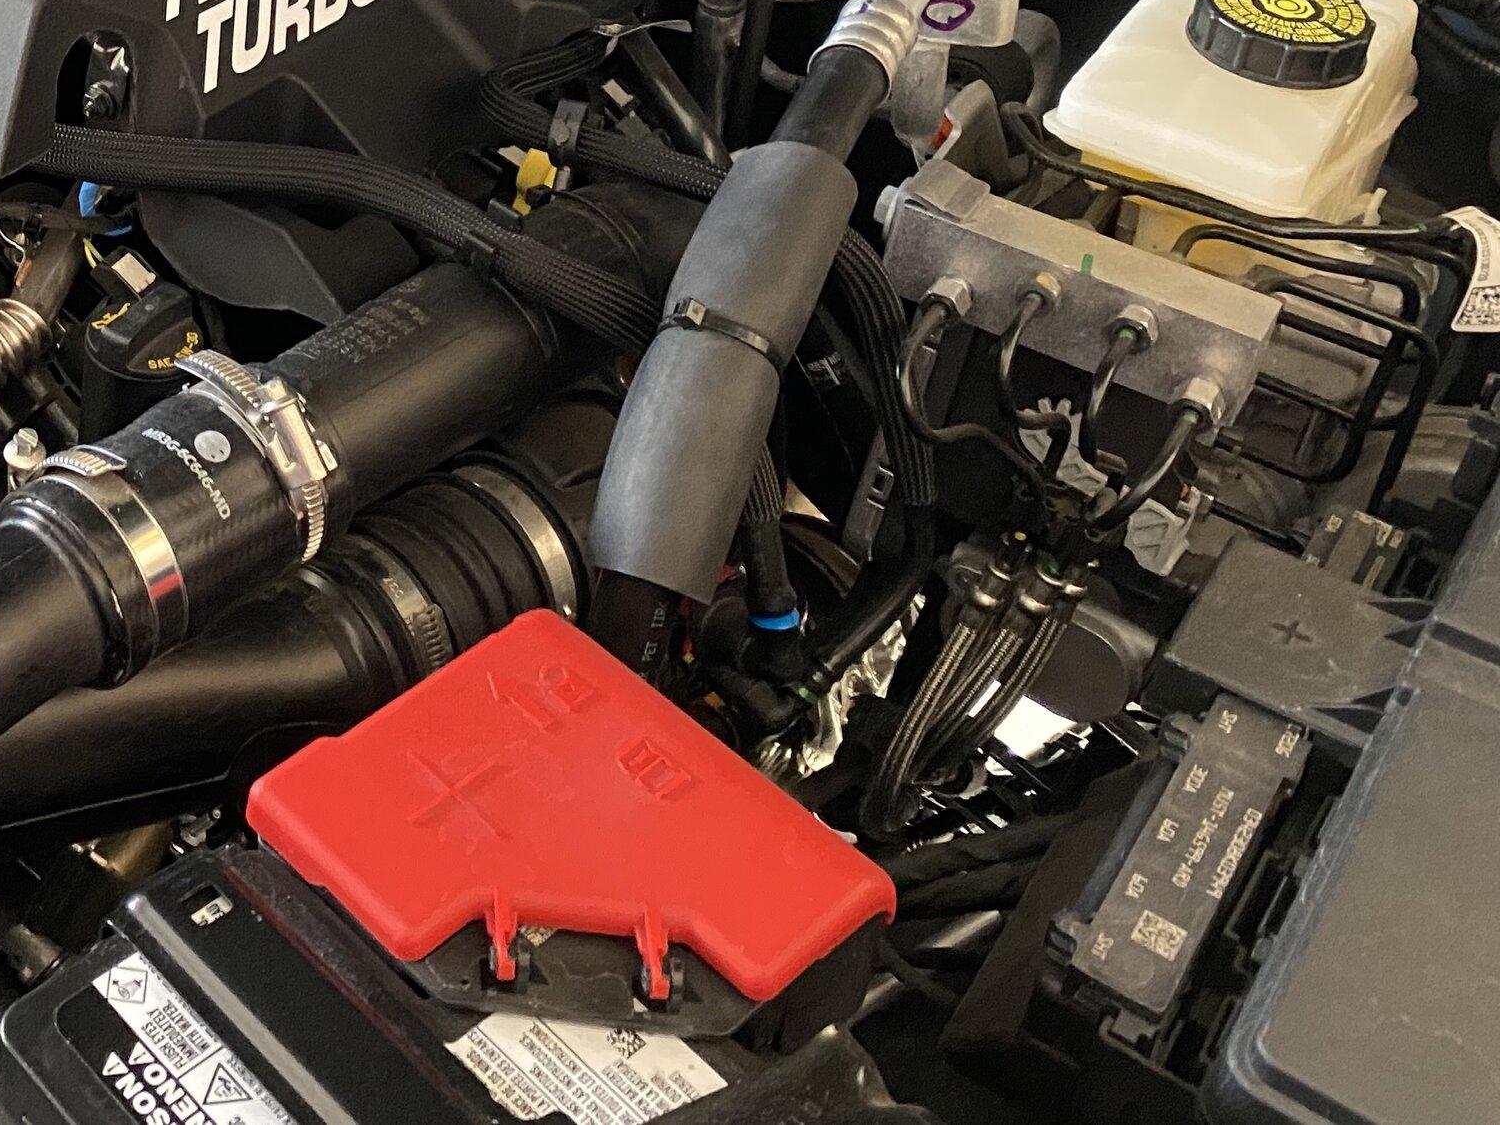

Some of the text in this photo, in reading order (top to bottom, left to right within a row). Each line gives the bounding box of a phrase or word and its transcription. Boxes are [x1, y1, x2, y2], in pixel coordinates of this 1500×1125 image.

[1184, 764, 1208, 792] 300A
[1157, 819, 1179, 842] 60A
[1126, 874, 1148, 898] 60A
[149, 1008, 198, 1059] IMMEDIATELY
[190, 1032, 210, 1053] WITH
[141, 1023, 190, 1069] FLUSH EYES
[495, 1059, 515, 1078] DES
[487, 1070, 506, 1089] LOS
[578, 1071, 596, 1089] LES
[501, 1084, 516, 1100] DE
[571, 1086, 590, 1105] LAS
[536, 1098, 550, 1113] LA
